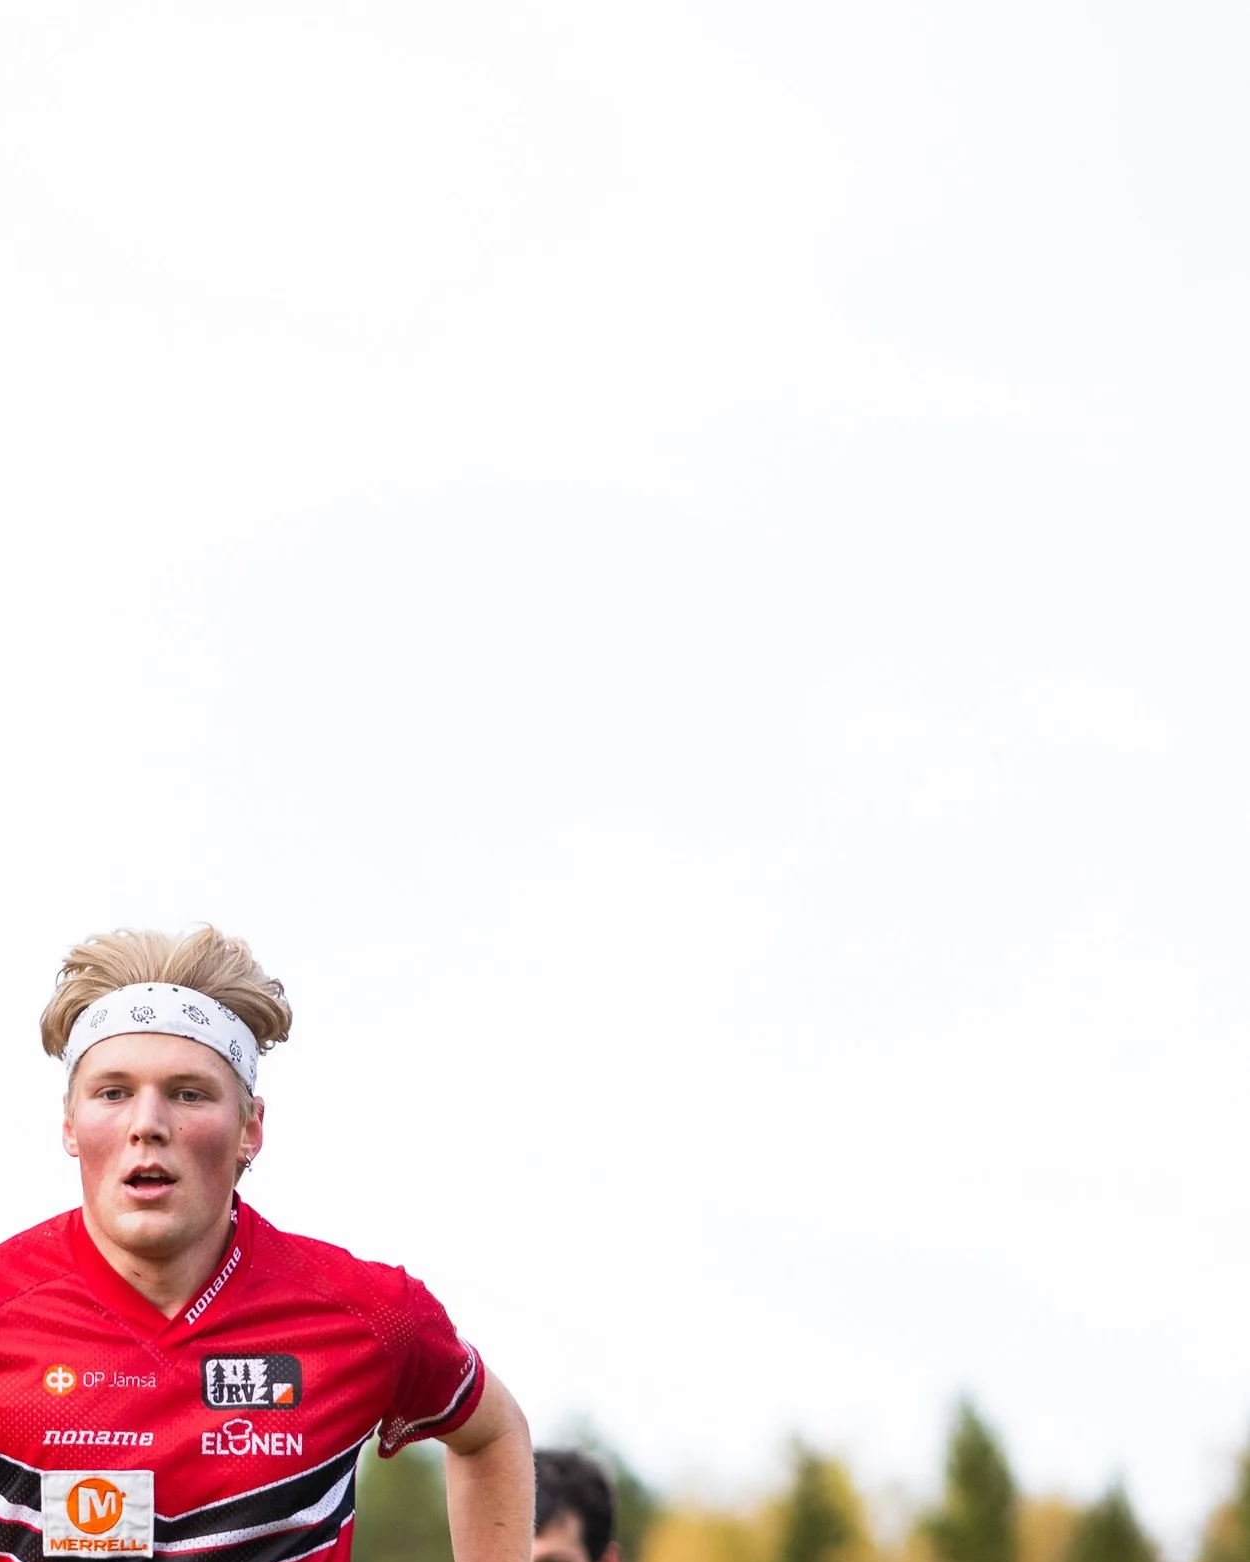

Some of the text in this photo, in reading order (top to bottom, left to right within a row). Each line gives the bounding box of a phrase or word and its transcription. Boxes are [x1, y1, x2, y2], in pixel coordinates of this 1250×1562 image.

[185, 1247, 241, 1325] noname
[83, 1371, 157, 1388] OP Jämsä
[213, 1384, 256, 1404] JRV
[43, 1430, 154, 1446] noname
